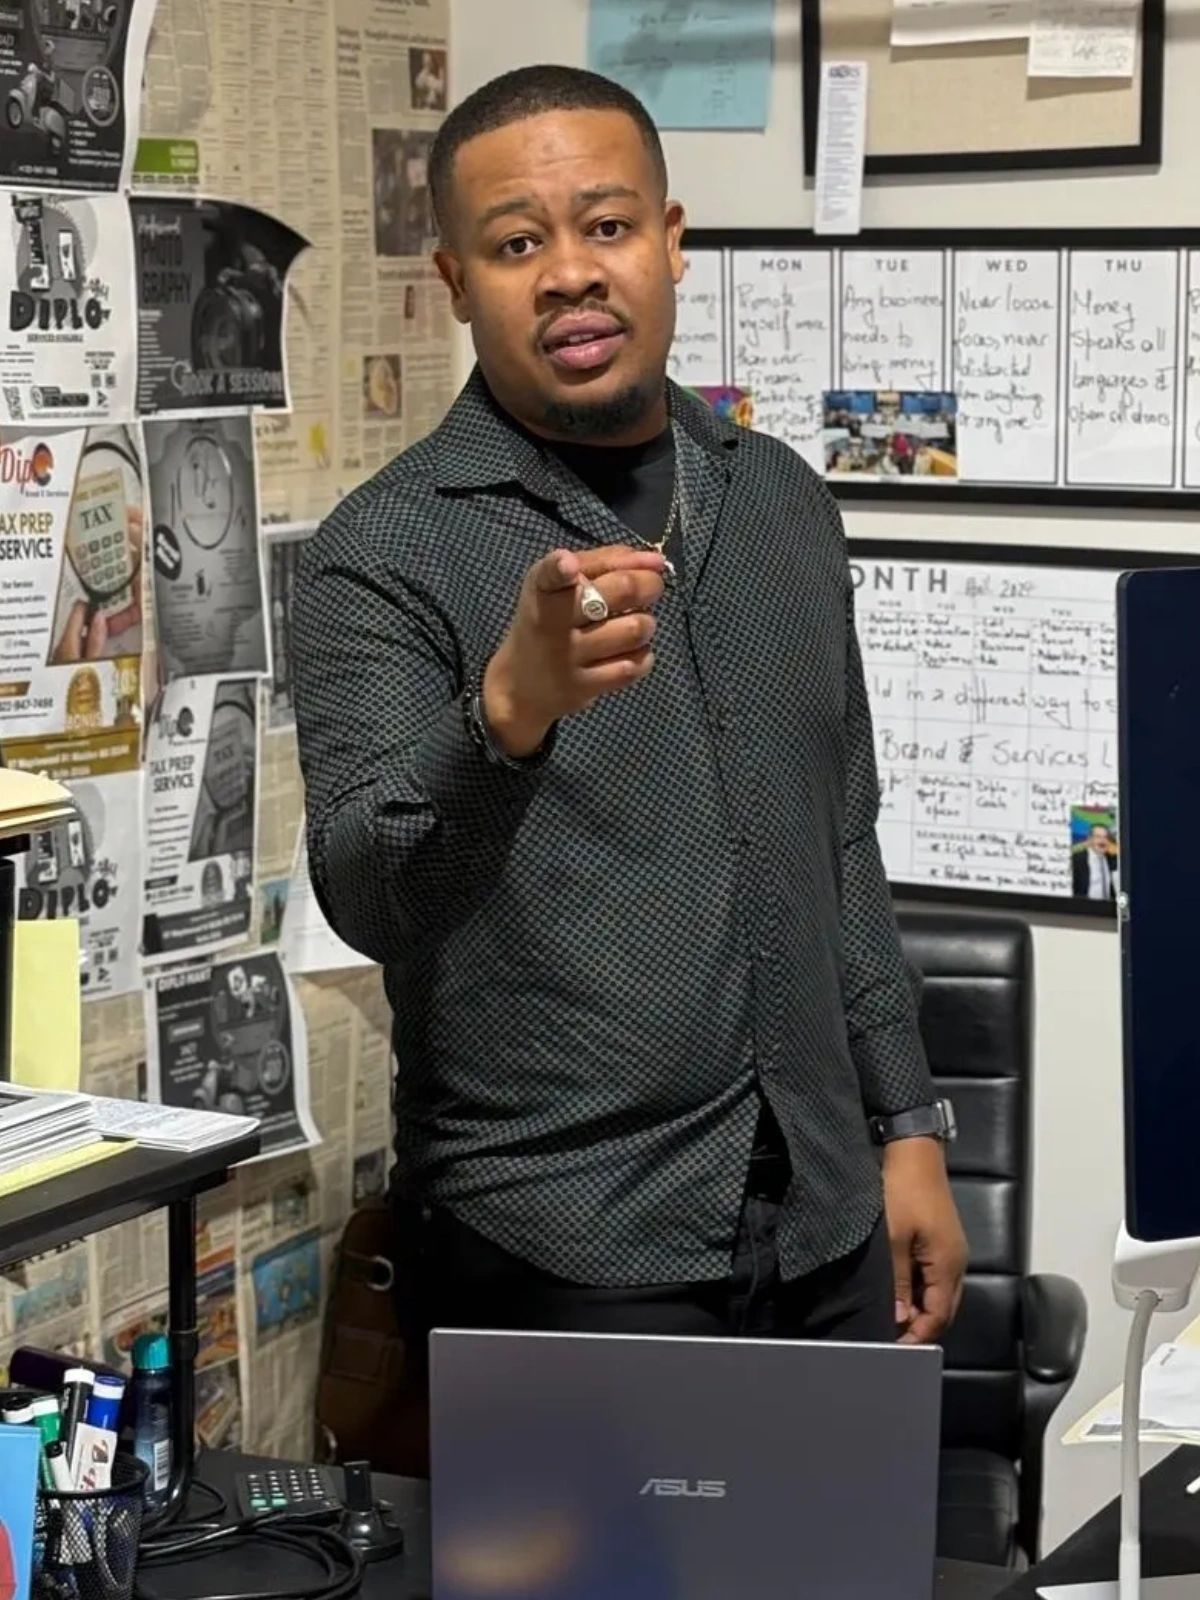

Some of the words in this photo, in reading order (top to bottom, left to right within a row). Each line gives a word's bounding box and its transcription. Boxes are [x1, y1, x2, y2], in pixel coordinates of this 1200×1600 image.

[760, 259, 803, 271] MON
[875, 259, 908, 271] TUE
[986, 259, 1027, 271] WED
[1104, 259, 1142, 271] THU
[958, 287, 1000, 313] Never
[0, 514, 18, 535] AX
[20, 512, 53, 534] PREP
[79, 505, 114, 530] TAX
[849, 565, 948, 593] ONTH
[879, 728, 947, 761] Brand
[993, 740, 1089, 768] Services
[150, 758, 168, 776] TAX
[169, 755, 195, 772] PREP
[153, 773, 194, 794] SERVICE
[639, 1478, 727, 1497] ASUS
